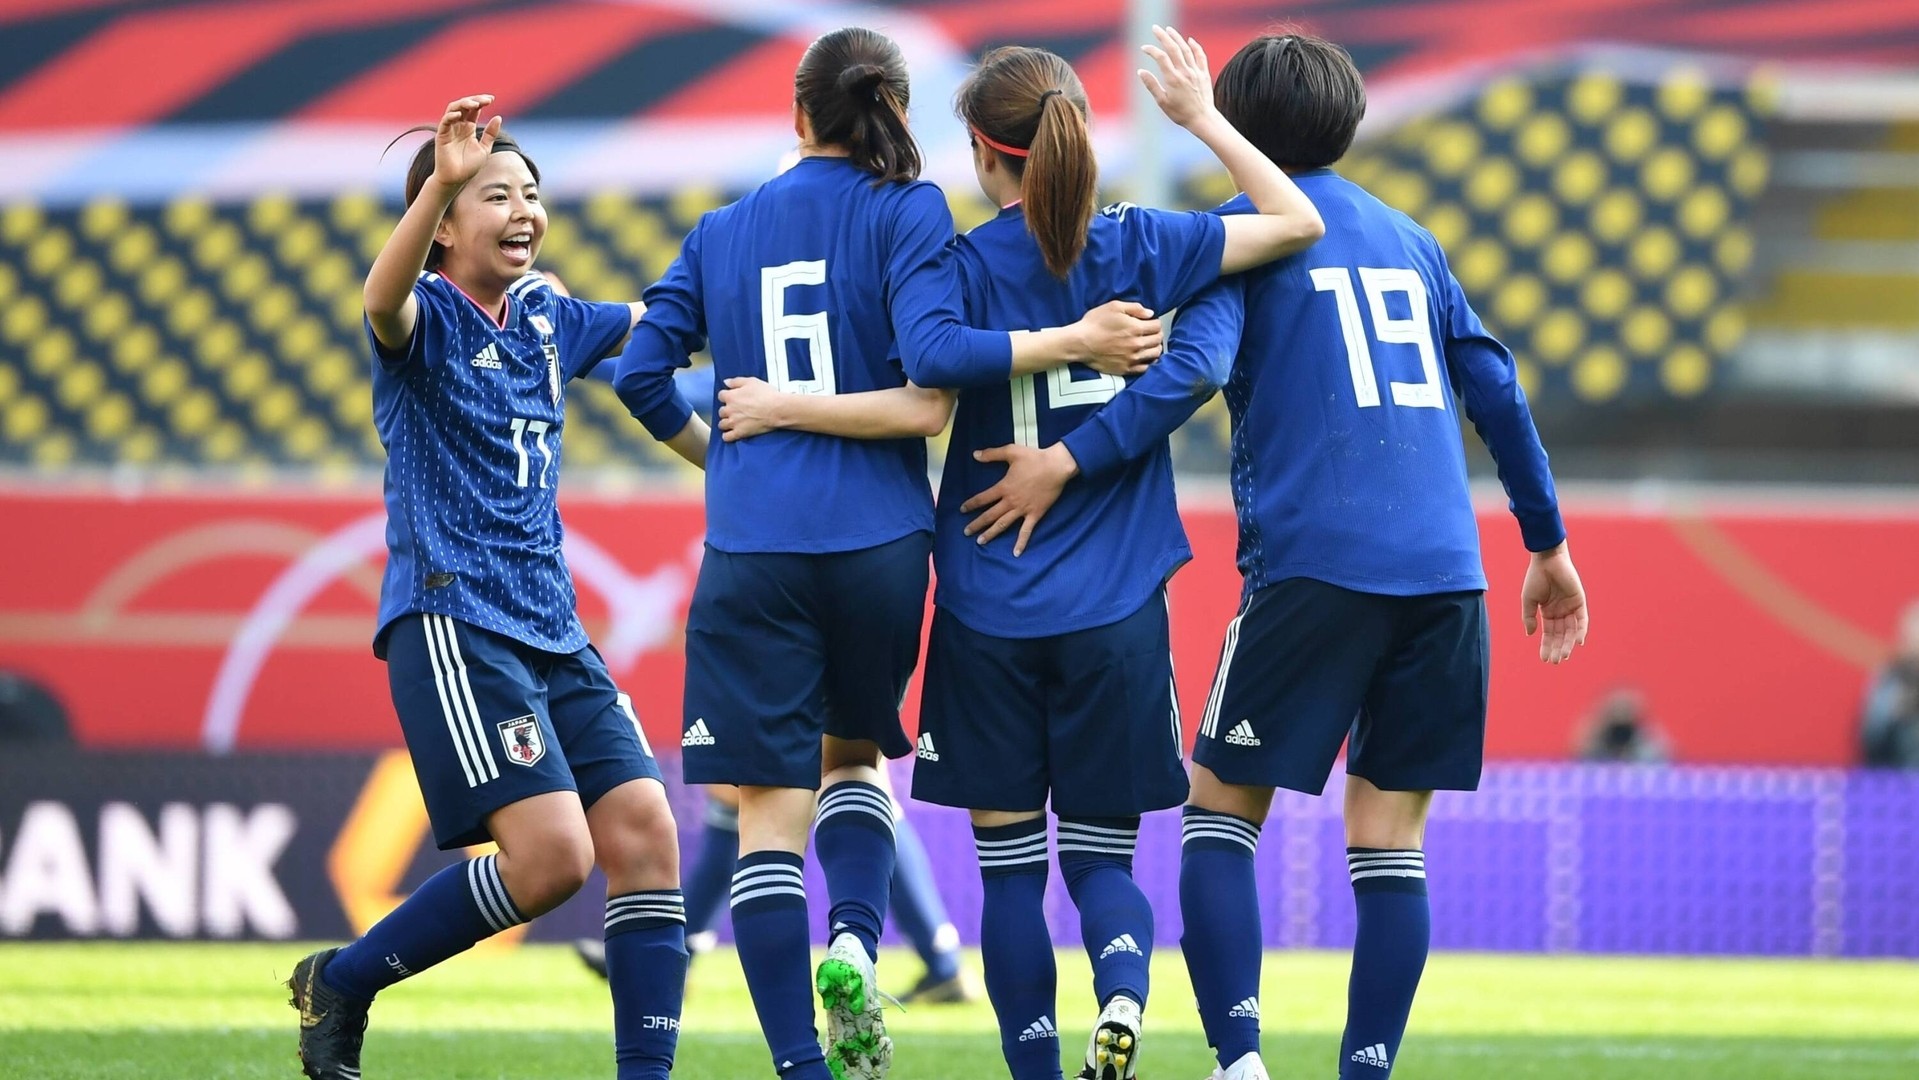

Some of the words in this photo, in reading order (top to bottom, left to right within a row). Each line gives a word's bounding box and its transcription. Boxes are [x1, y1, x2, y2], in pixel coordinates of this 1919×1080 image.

[761, 259, 836, 395] 6
[1309, 267, 1445, 410] 19
[471, 358, 502, 370] adidas
[510, 418, 551, 489] 17
[681, 735, 715, 747] adidas
[1225, 734, 1261, 747] adidas
[0, 801, 298, 938] ANK
[1100, 945, 1142, 960] adidas
[1351, 1054, 1389, 1069] adidas
